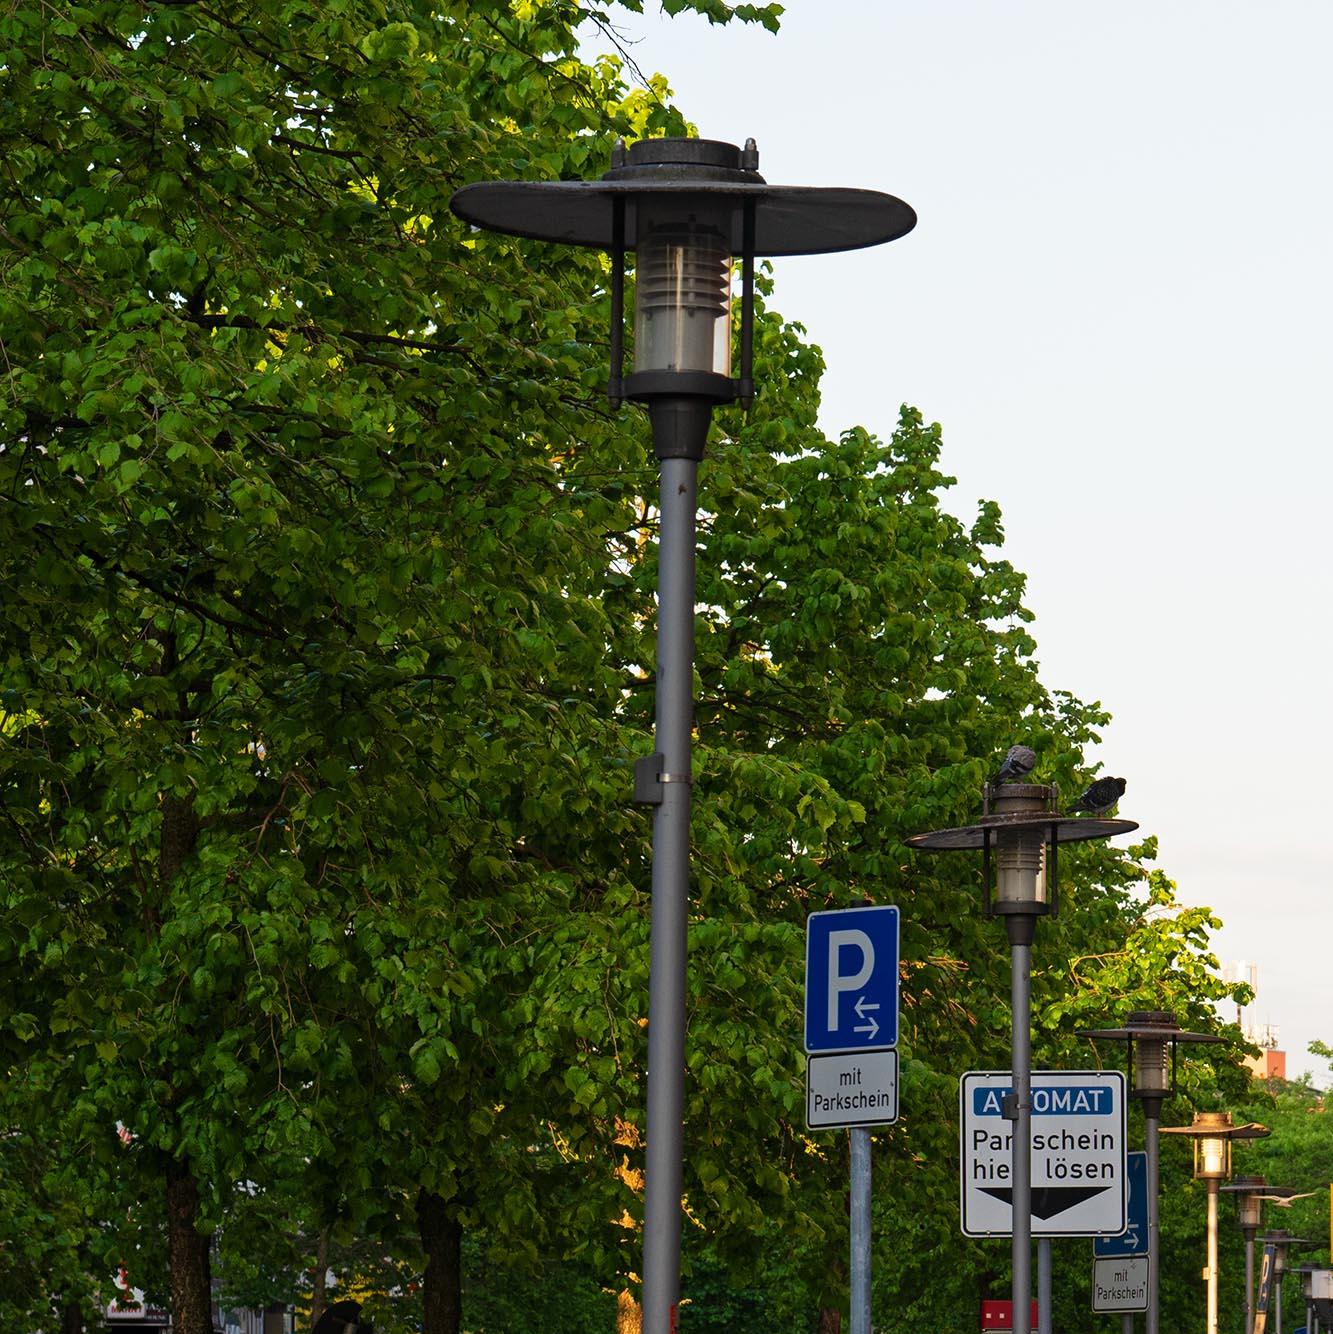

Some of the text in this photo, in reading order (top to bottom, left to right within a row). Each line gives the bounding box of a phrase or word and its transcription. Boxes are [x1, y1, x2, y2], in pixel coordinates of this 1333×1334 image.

[827, 929, 876, 1033] P
[839, 1067, 862, 1087] mit
[814, 1090, 890, 1114] Parkschein
[983, 1089, 1105, 1113] AOMAT
[973, 1128, 1114, 1151] Parschein
[973, 1157, 1114, 1180] hie lösen
[1114, 1268, 1128, 1282] mit
[1097, 1284, 1144, 1300] Parkschein
